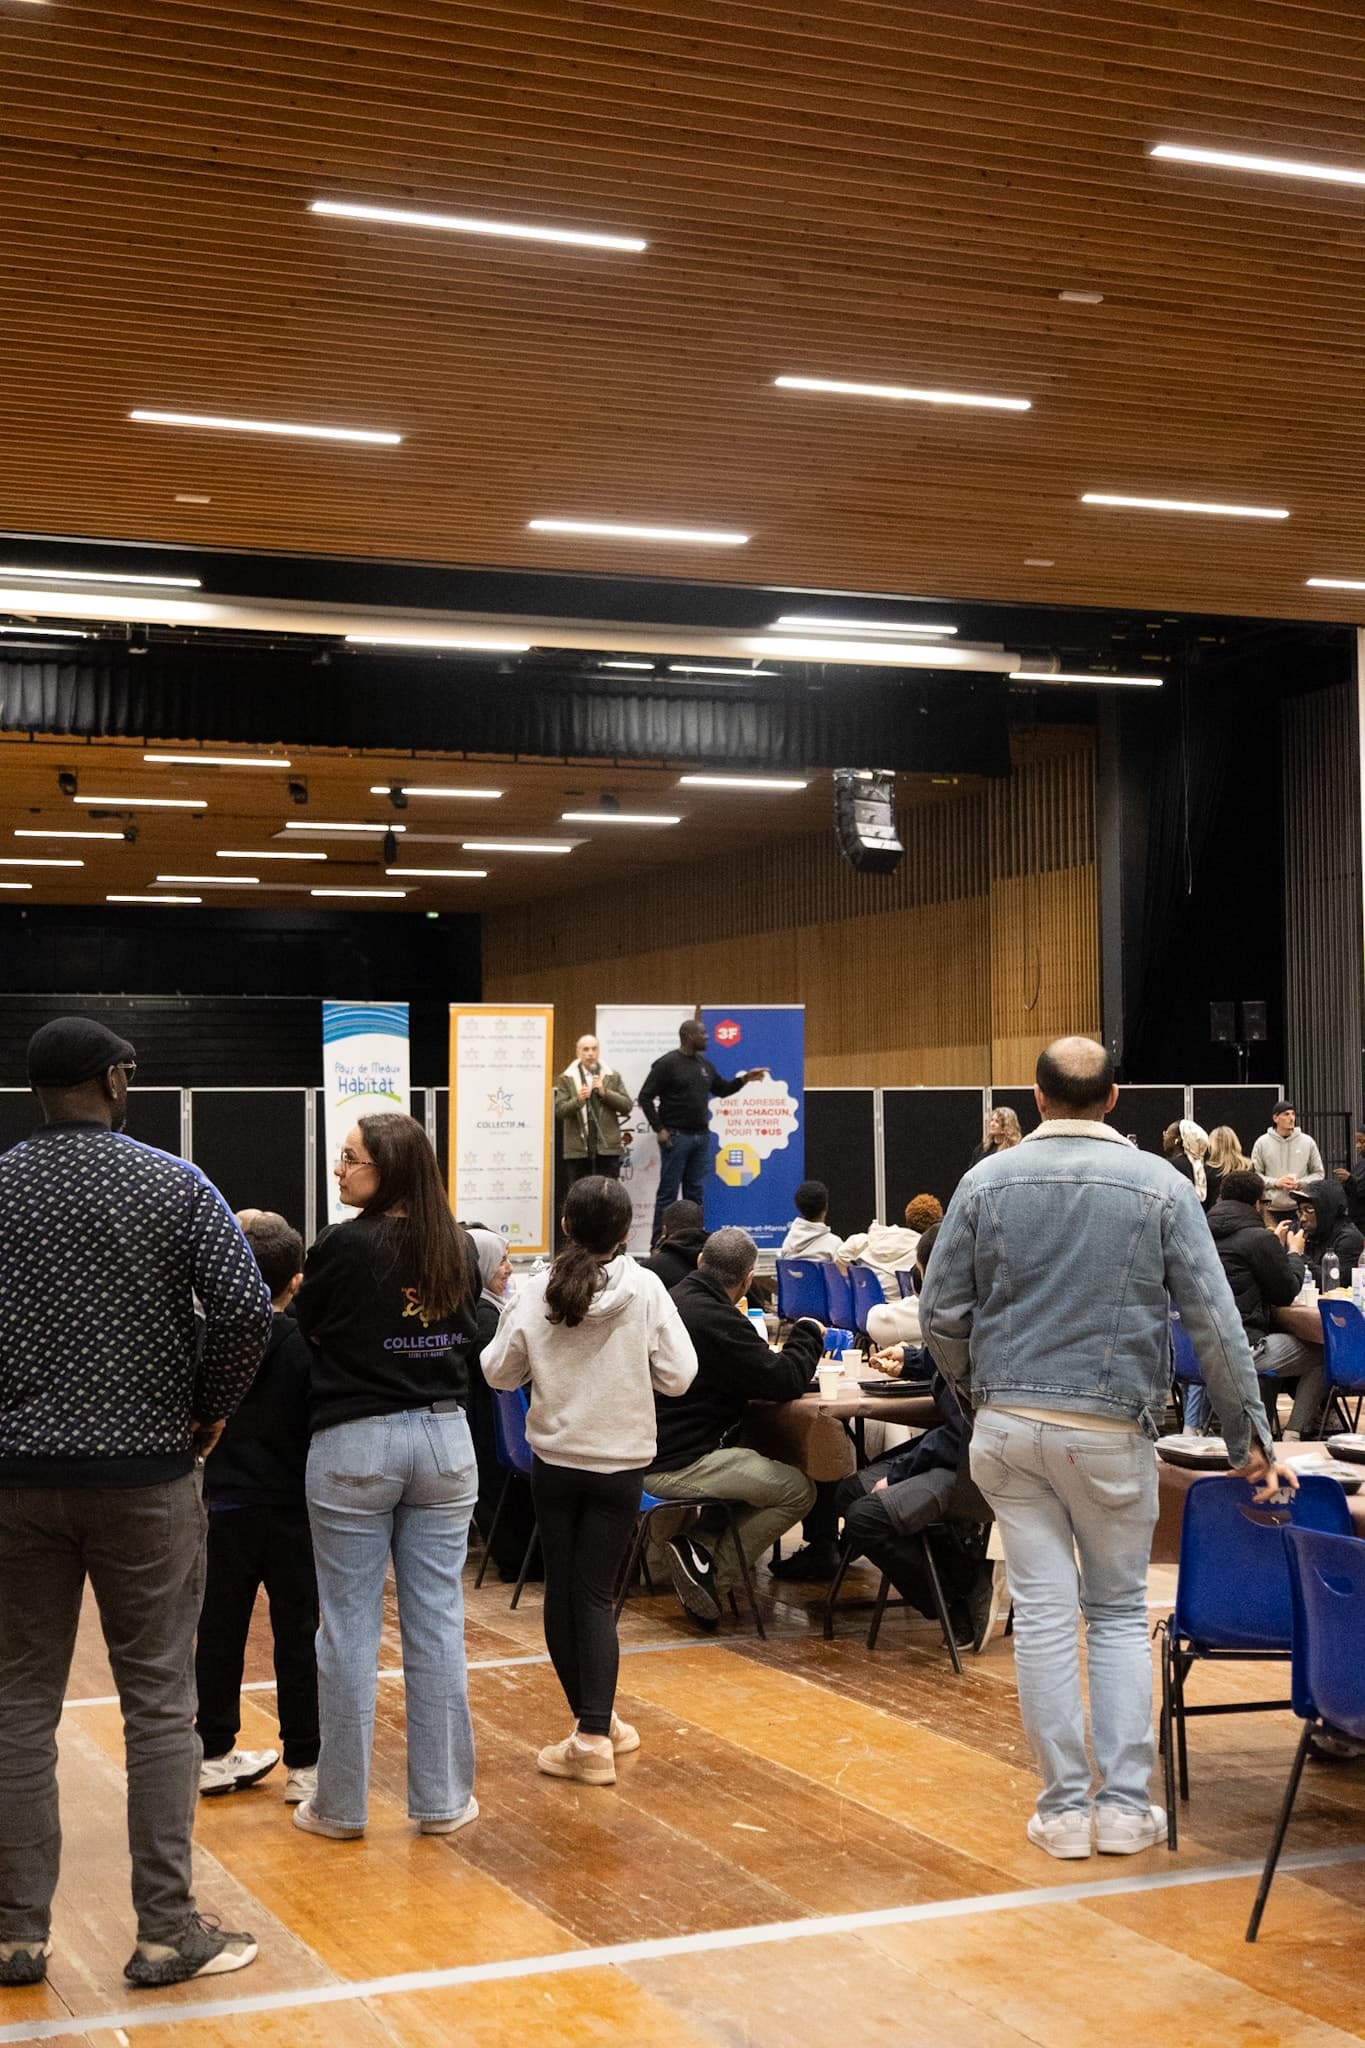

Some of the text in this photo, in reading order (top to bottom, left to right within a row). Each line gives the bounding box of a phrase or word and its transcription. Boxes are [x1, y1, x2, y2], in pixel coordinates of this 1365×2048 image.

[717, 1027, 739, 1040] 3F
[335, 1061, 400, 1075] Pays de Meaux
[338, 1076, 395, 1094] Habitat
[720, 1098, 785, 1106] UNE ADRESSE
[715, 1108, 792, 1117] POUR CHACUN,
[727, 1118, 779, 1126] UN AVENIR
[725, 1128, 783, 1136] POUR TOUS
